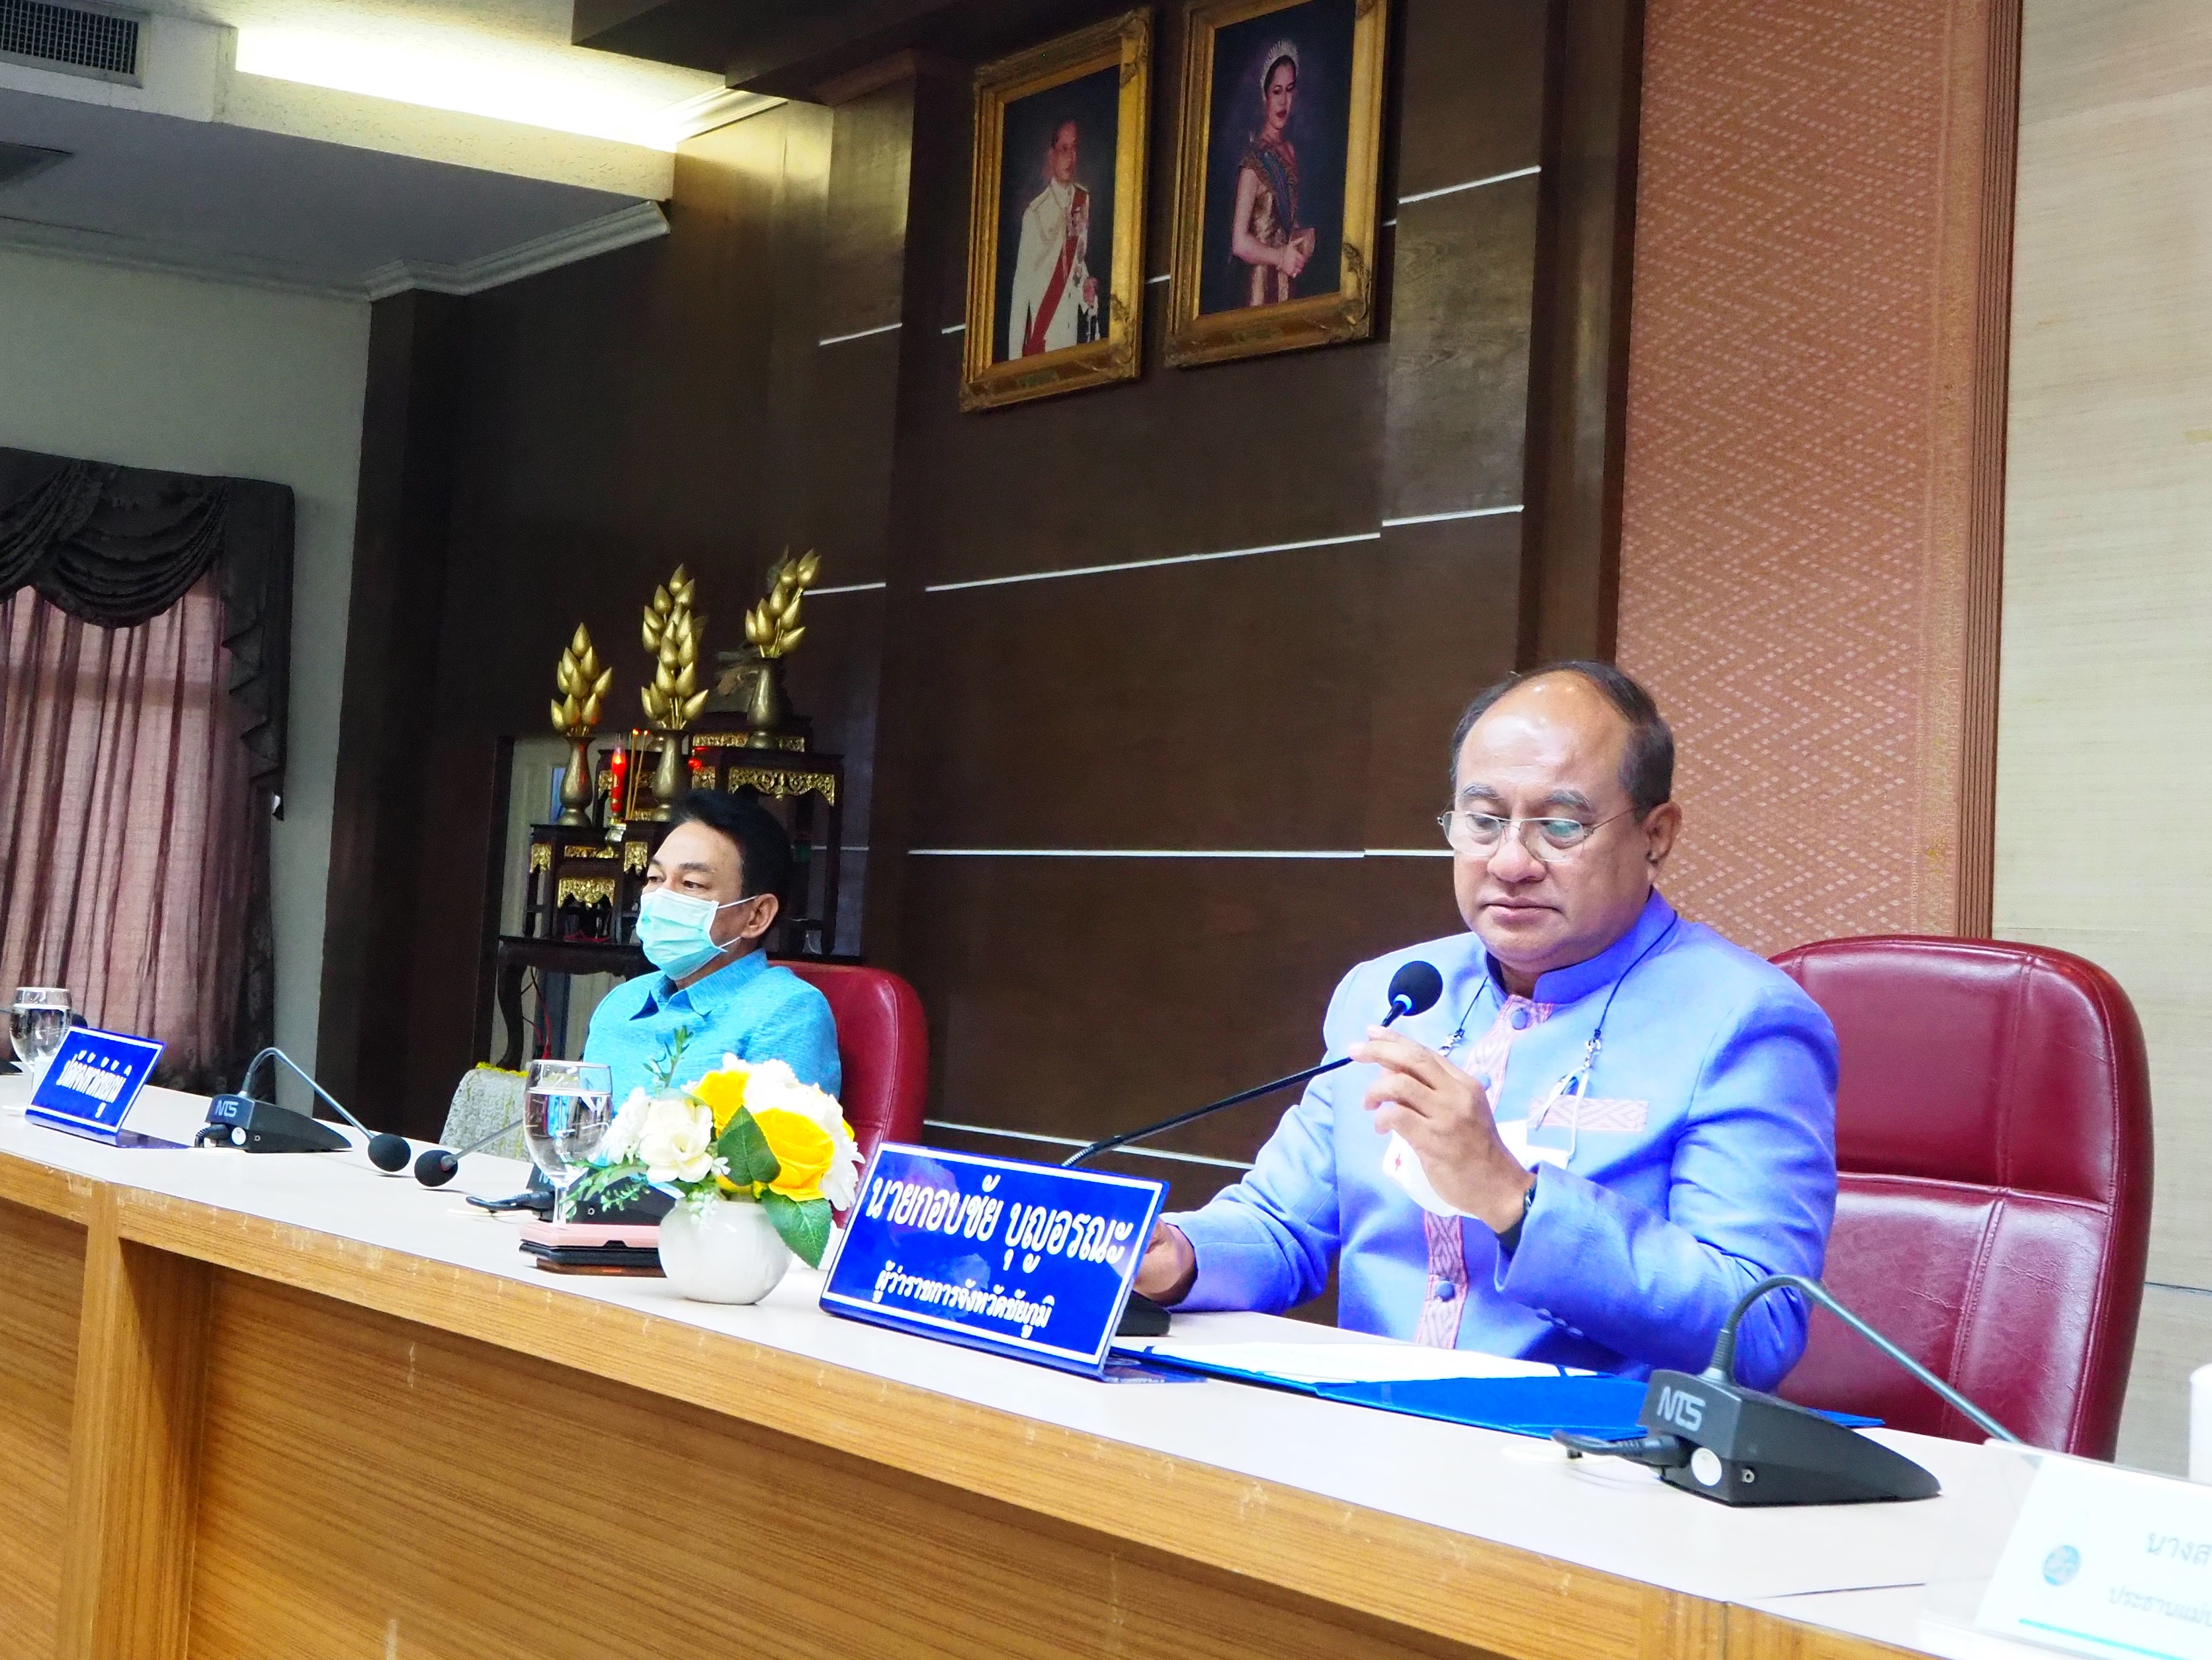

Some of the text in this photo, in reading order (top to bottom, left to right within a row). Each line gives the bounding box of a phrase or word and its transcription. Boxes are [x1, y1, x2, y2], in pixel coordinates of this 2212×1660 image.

[866, 1174, 1134, 1274] นายกอบชัย บุญอรณะ
[872, 1260, 1055, 1338] ผู้ว่าราชการจังหวัดชัยภูมิ
[1657, 1386, 1706, 1432] NTS
